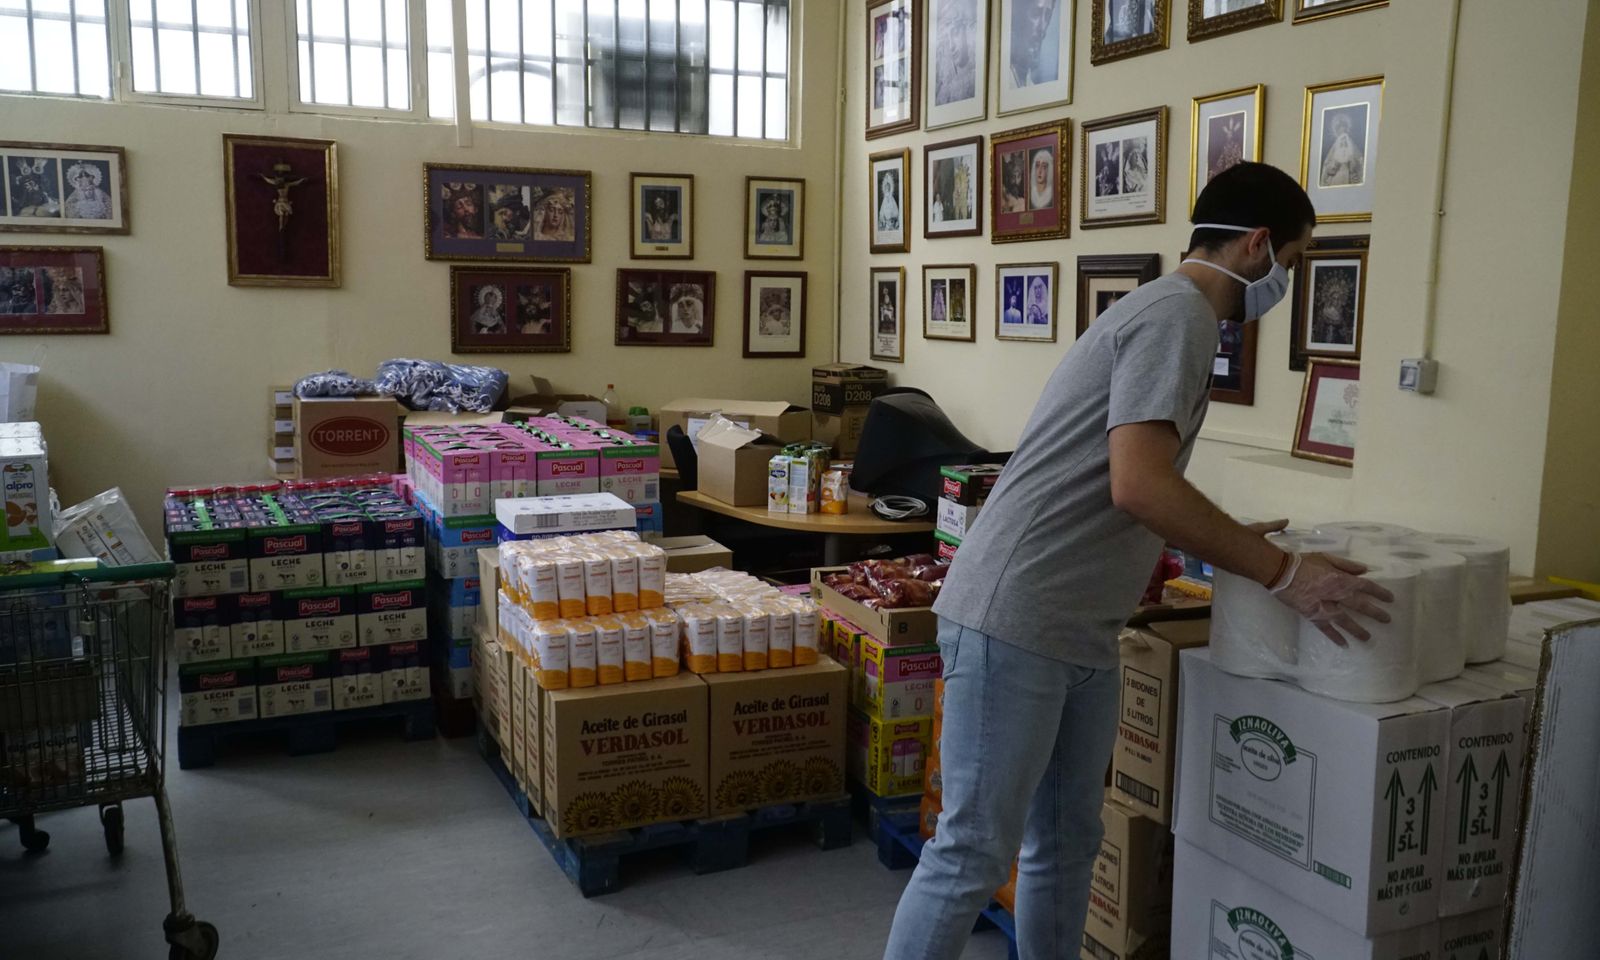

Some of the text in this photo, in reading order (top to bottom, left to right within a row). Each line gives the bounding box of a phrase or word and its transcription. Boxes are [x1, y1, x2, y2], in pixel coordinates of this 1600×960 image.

[814, 392, 832, 406] D208
[845, 390, 872, 401] D208
[317, 428, 380, 442] TORRENT
[552, 462, 583, 472] Pascual
[617, 462, 642, 471] Pascual
[6, 481, 33, 491] alpro
[335, 526, 360, 534] Pascual
[387, 521, 411, 529] Pascual
[462, 530, 491, 541] Pascual
[267, 538, 302, 550] Pascual
[194, 546, 225, 558] Pascual
[195, 563, 226, 572] LECHE
[272, 558, 301, 567] LECHE
[302, 600, 336, 611] Pascual
[374, 594, 408, 605] Pascual
[306, 620, 335, 628] LECHE
[378, 613, 406, 621] LECHE
[900, 660, 938, 671] Pascual
[281, 682, 310, 692] LECHE
[1131, 679, 1158, 697] BIDONES
[204, 691, 234, 700] LECHE
[1136, 696, 1144, 707] DE
[734, 693, 830, 716] Aceite de Girasol
[581, 710, 687, 735] Aceite de Girasol
[733, 711, 830, 736] VERDASOL
[1131, 710, 1153, 726] LITROS
[1238, 717, 1289, 747] IZNAOLIVA
[581, 728, 688, 756] VERDASOL
[1120, 726, 1160, 753] VERDASOL
[1459, 732, 1514, 749] CONTENIDO
[1386, 745, 1440, 764] CONTENIDO
[1480, 783, 1489, 800] 3
[1406, 798, 1415, 815] 3
[1470, 818, 1491, 836] 5L.
[1397, 834, 1418, 852] 5L.
[1459, 849, 1496, 865] NO APILAR
[1099, 862, 1107, 873] DE
[1387, 864, 1424, 883] NO APILAR
[1467, 868, 1476, 879] DE
[1095, 875, 1114, 893] LITROS
[1377, 884, 1392, 901] MÁS
[1395, 885, 1403, 898] DE
[1412, 878, 1432, 893] CAJAS
[1235, 909, 1286, 945] IZNAOLIVA
[1444, 930, 1494, 951] CONTENIDO
